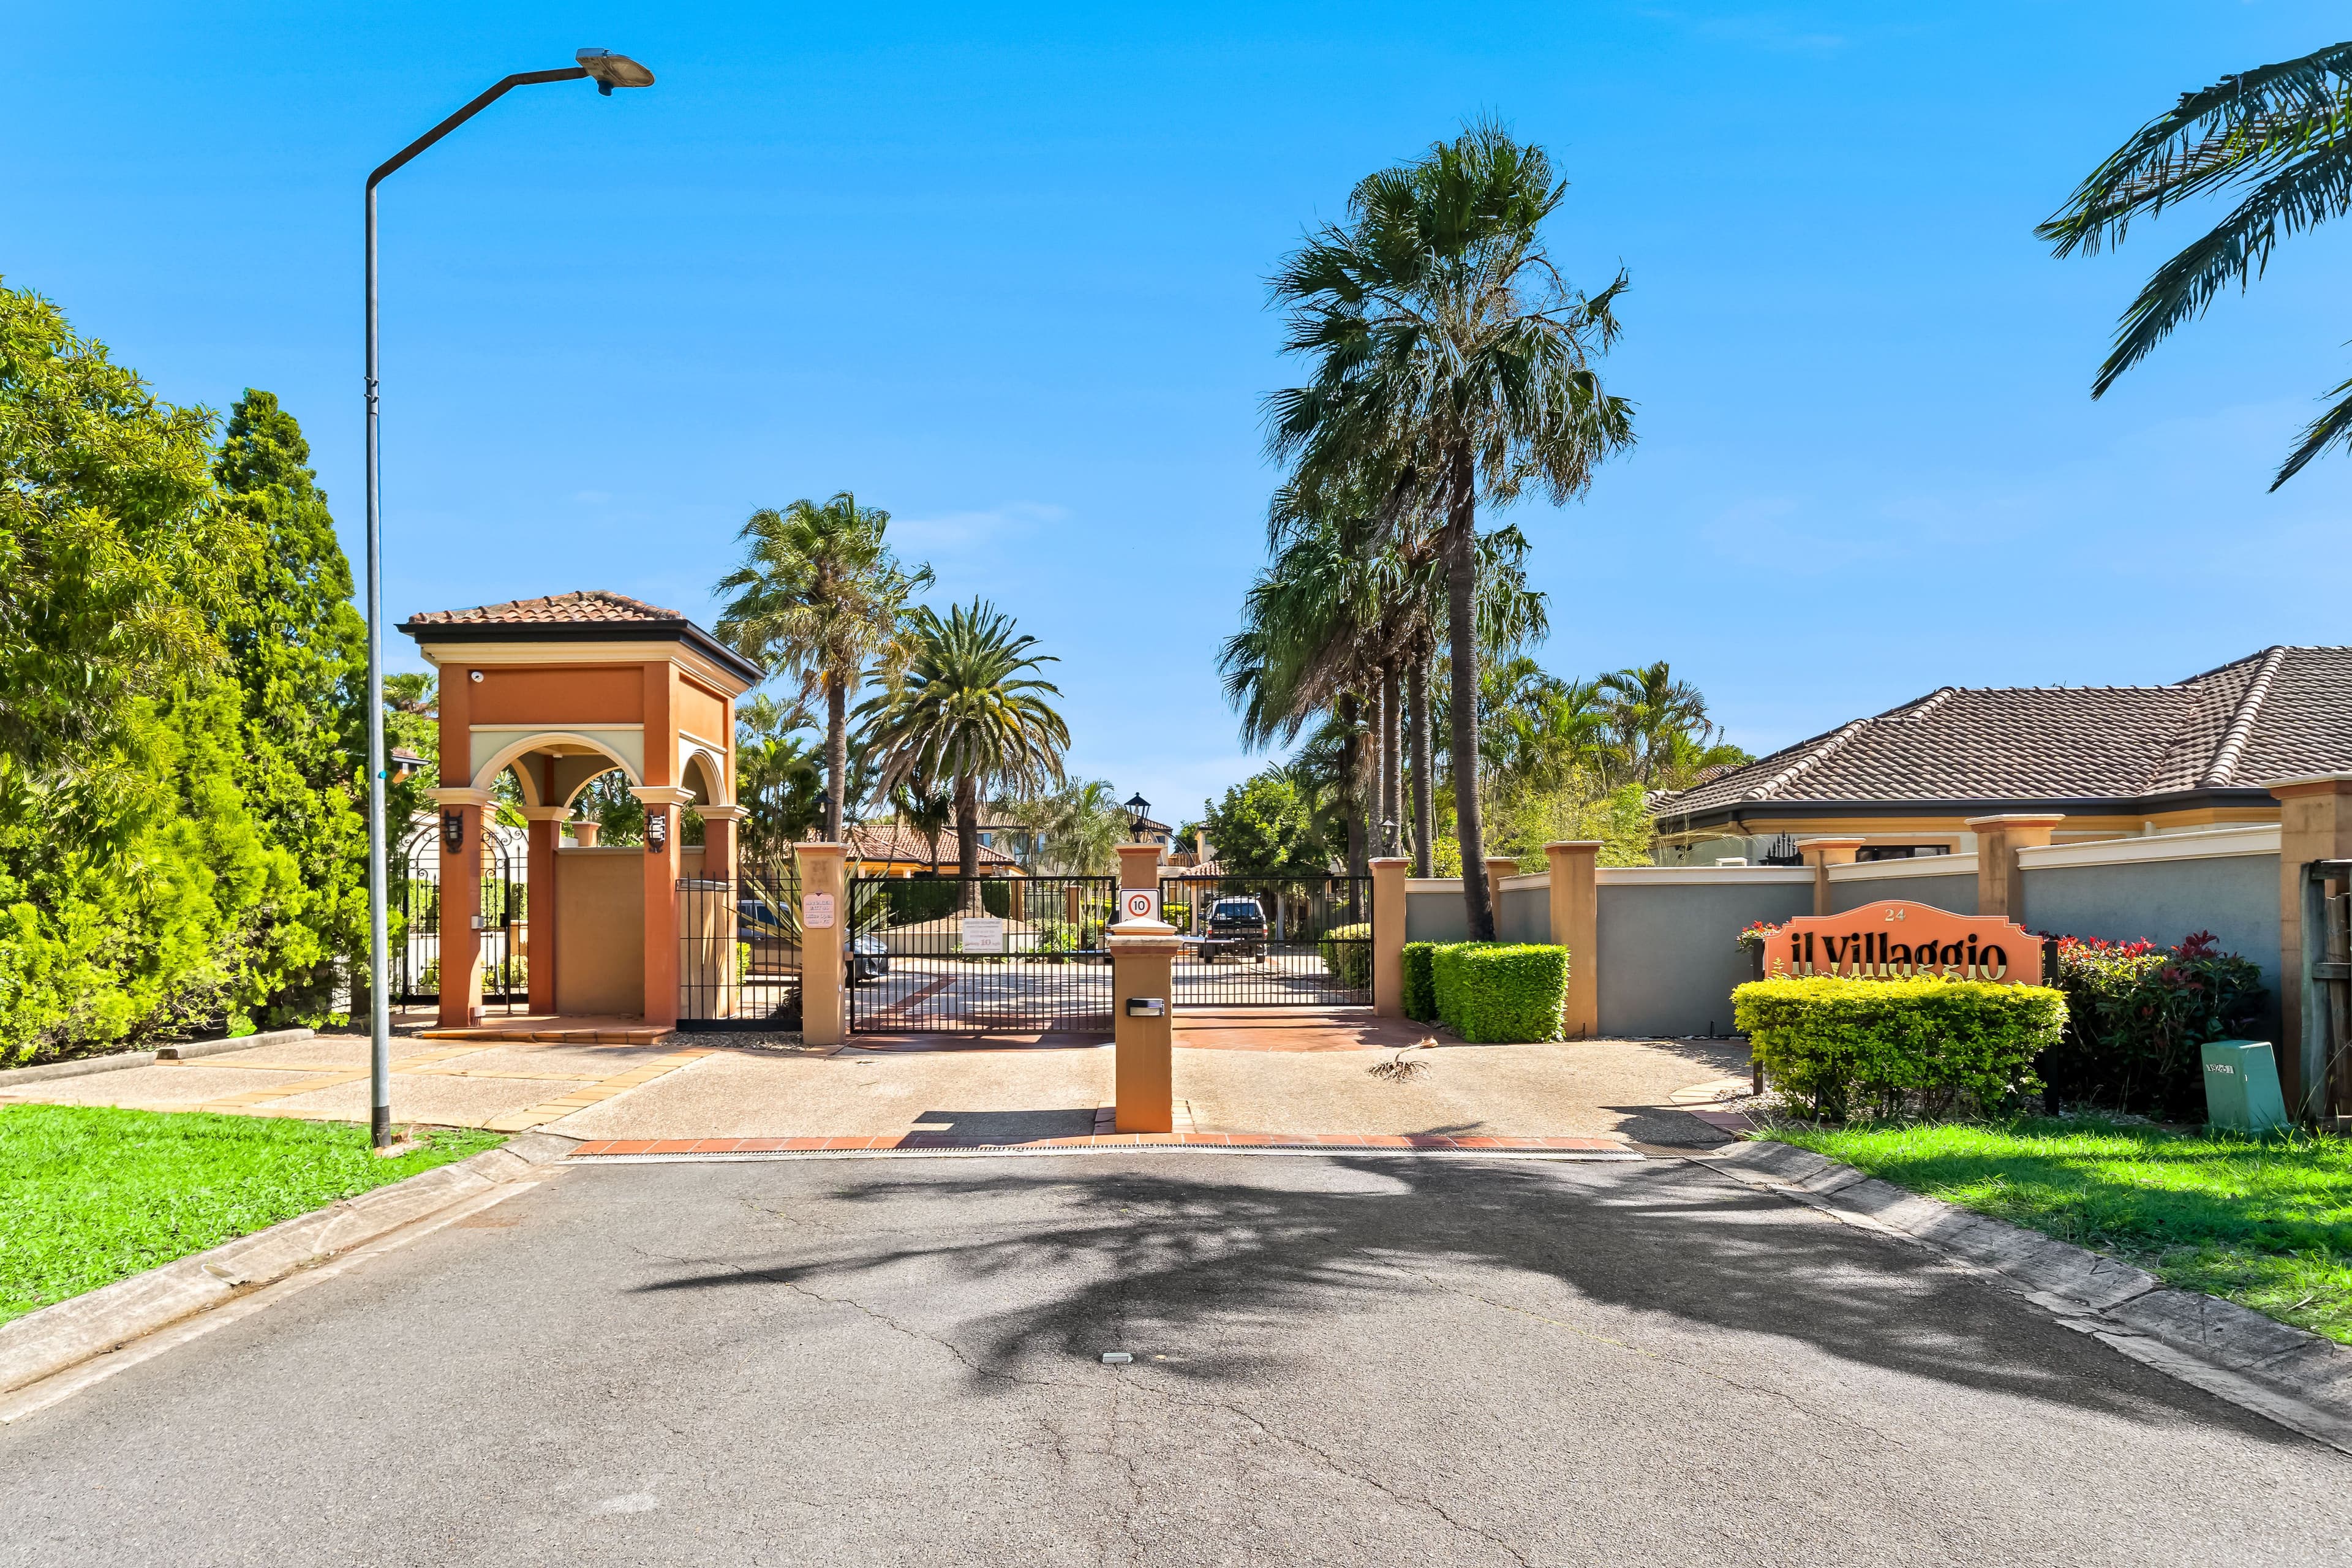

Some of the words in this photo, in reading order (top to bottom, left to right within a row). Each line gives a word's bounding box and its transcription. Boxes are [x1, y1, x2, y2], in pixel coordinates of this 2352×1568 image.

[1134, 900, 1145, 911] 10
[1885, 908, 1906, 922] 24
[1790, 932, 1814, 976] il
[1821, 932, 2007, 983] Villaggio
